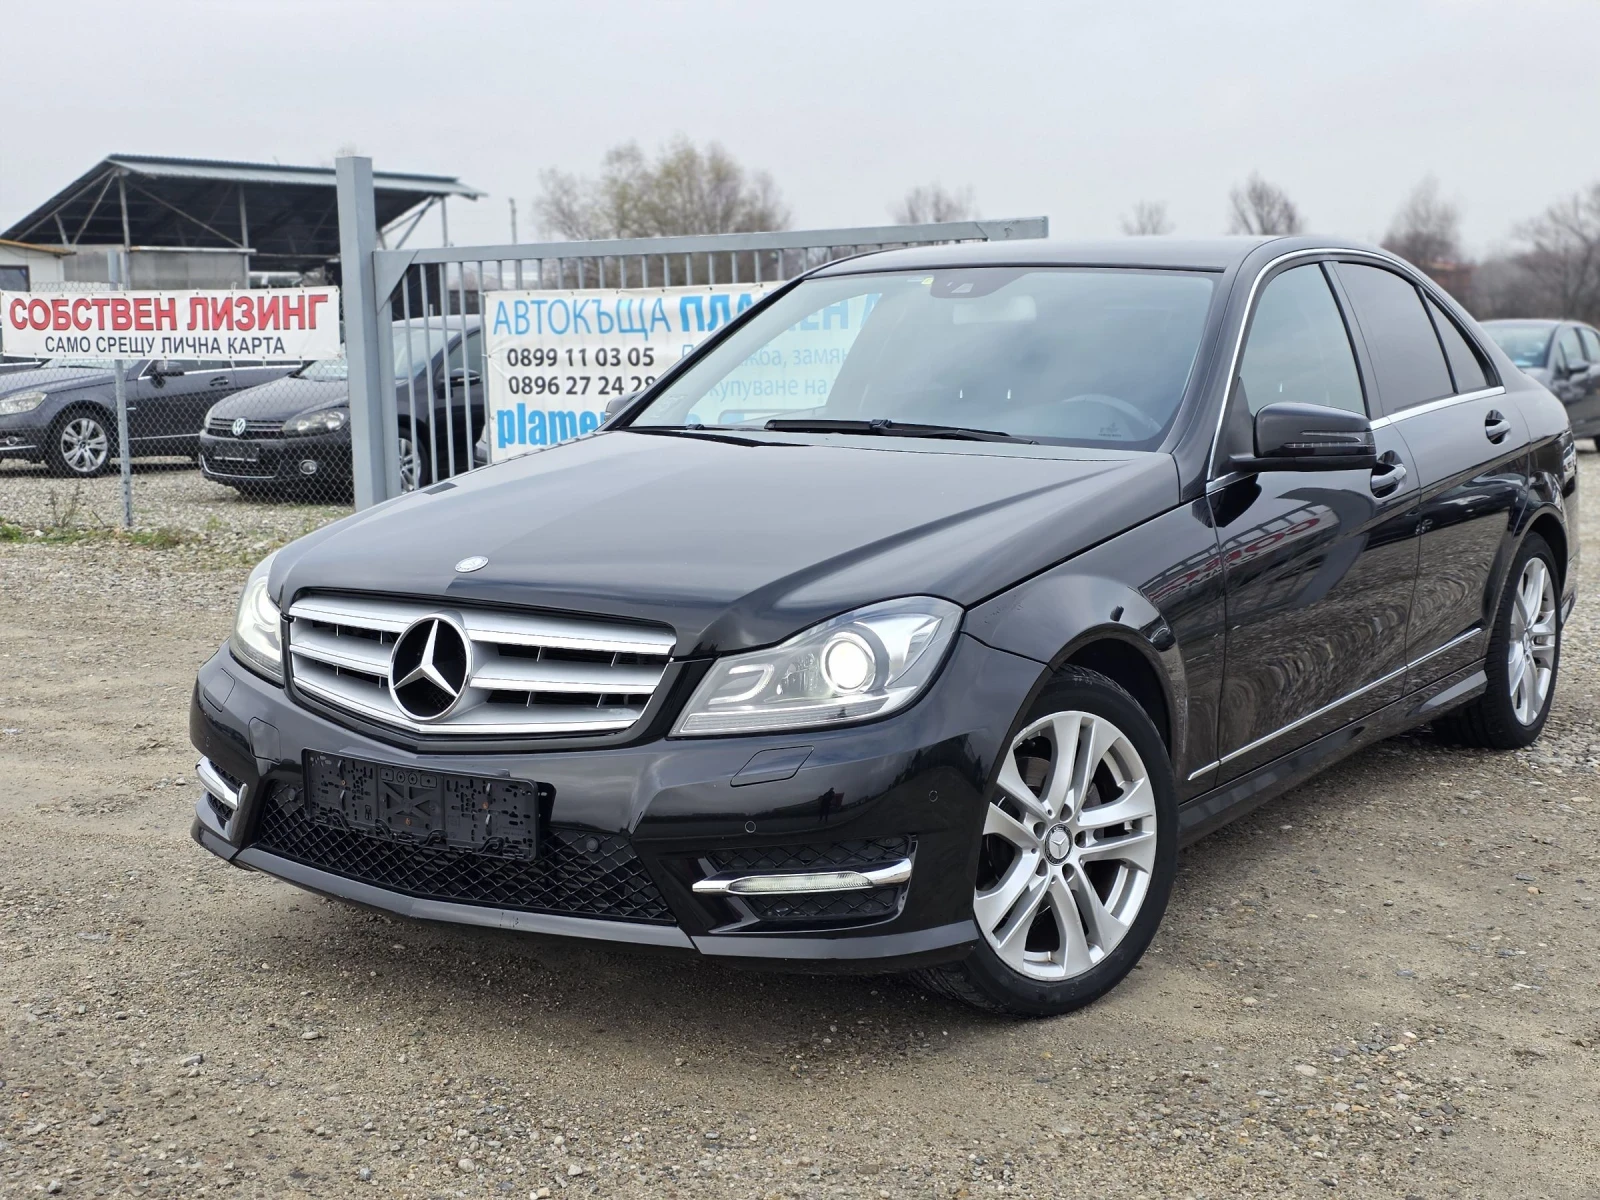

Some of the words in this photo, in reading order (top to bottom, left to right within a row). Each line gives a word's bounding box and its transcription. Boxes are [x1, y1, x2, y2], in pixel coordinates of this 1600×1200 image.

[9, 296, 178, 331] СОБСТВЕН
[187, 293, 329, 331] ЛИЗИНГ
[493, 298, 671, 341] АВТОКЪЩА
[45, 336, 91, 353] САМО
[96, 336, 156, 356] СРЕЩУ
[161, 336, 222, 354] ЛИЧНА
[228, 336, 286, 354] КАРТА
[507, 348, 558, 367] 0899
[566, 348, 588, 367] 11
[595, 348, 621, 367] 03
[628, 347, 655, 366] 05
[508, 376, 560, 395] 0896
[566, 376, 591, 395] 27
[598, 376, 624, 395] 24
[805, 378, 828, 397] на
[497, 403, 606, 448] plame
